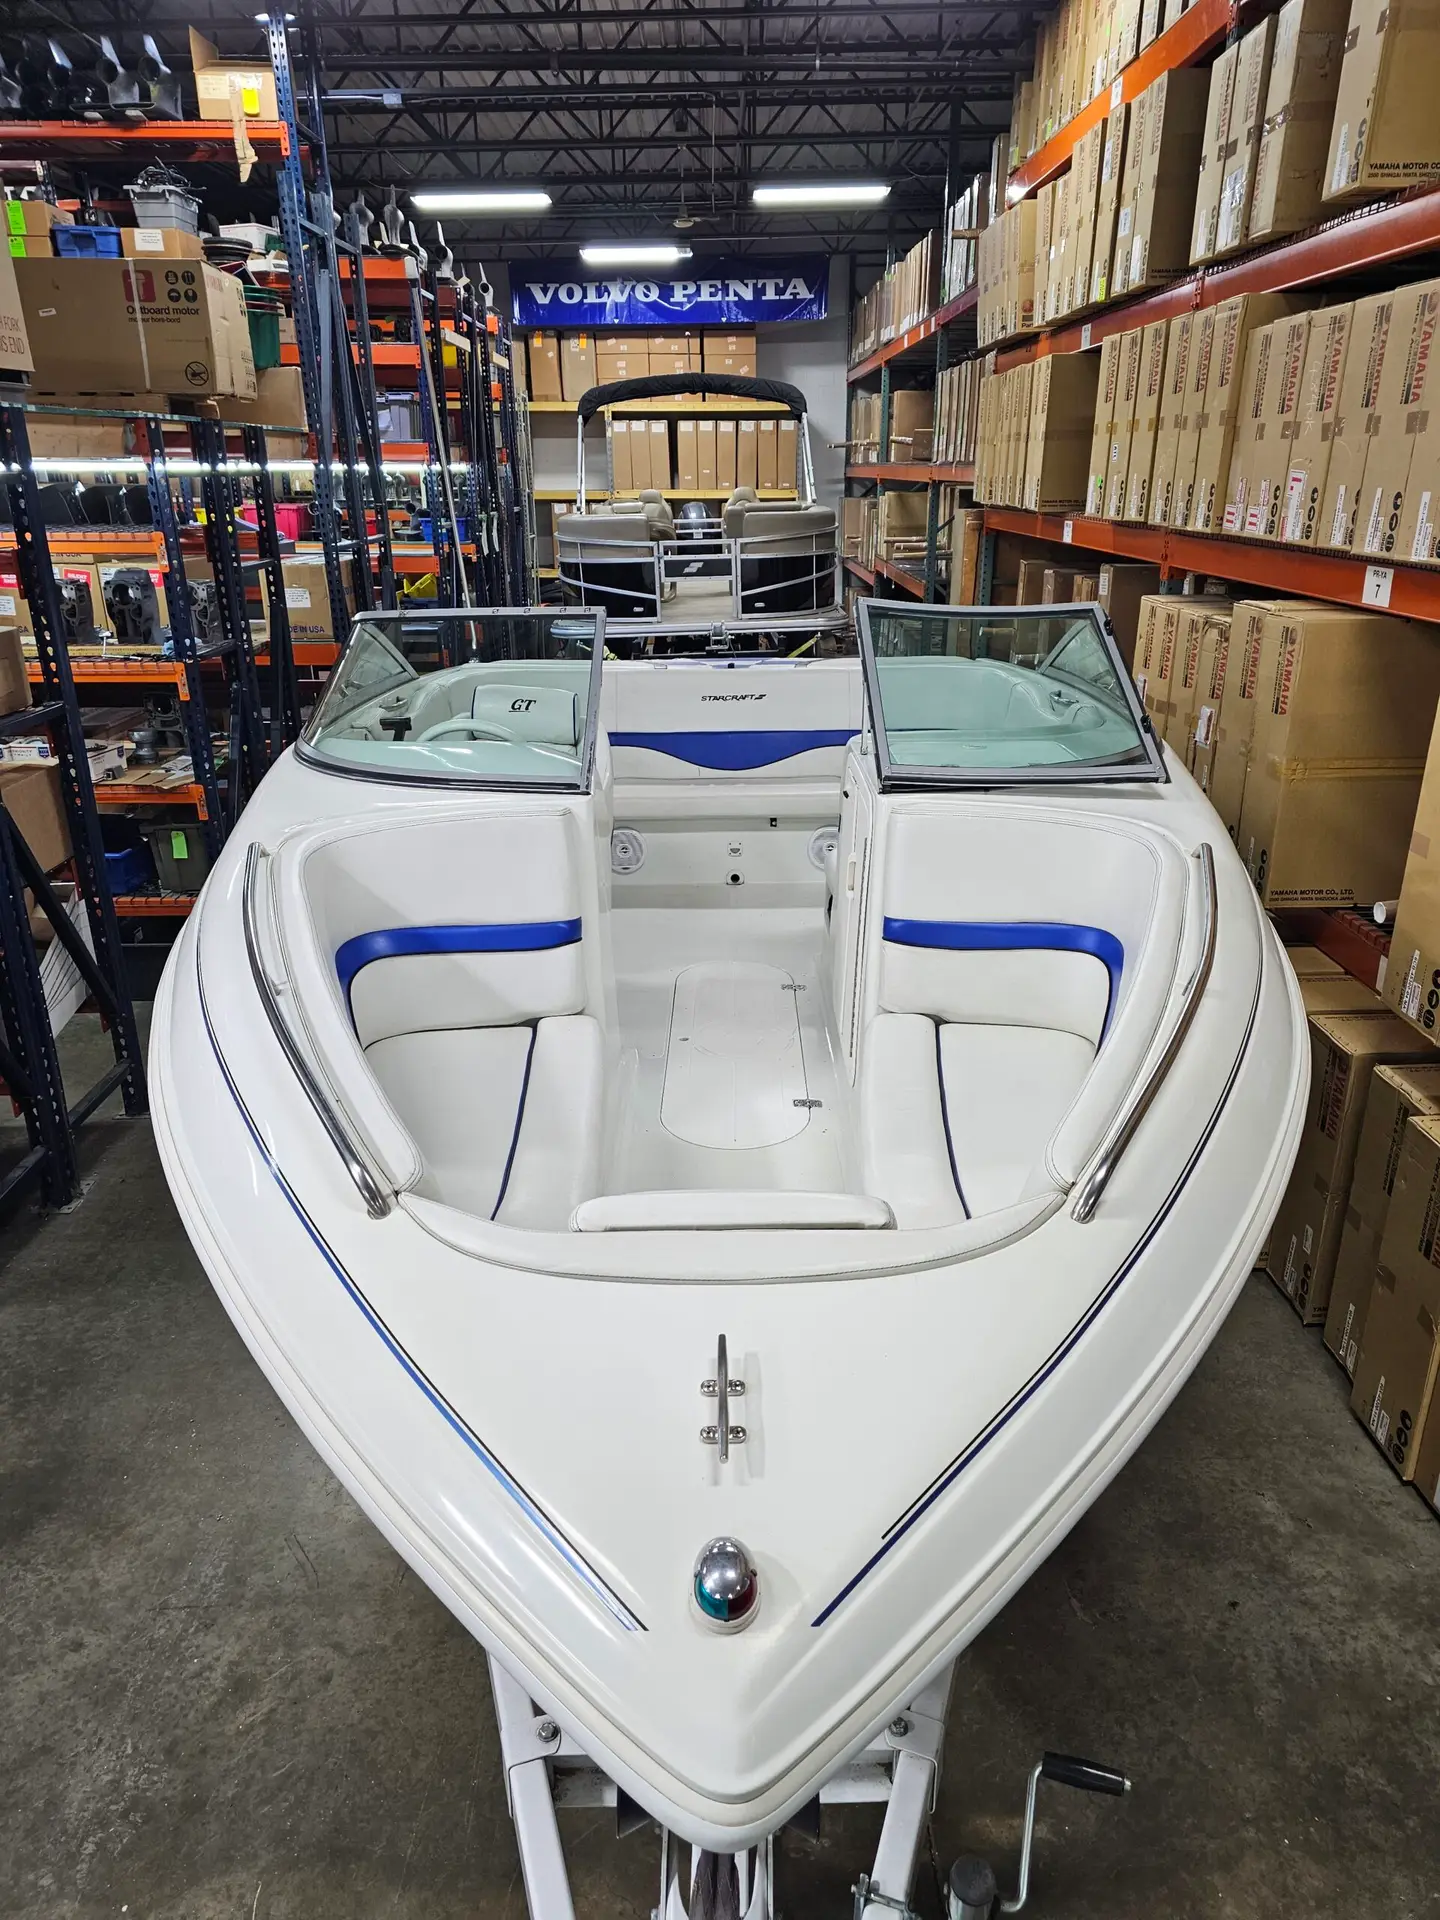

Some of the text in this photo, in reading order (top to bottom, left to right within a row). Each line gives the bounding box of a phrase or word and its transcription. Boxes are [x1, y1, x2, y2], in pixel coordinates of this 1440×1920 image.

[1369, 162, 1400, 170] YAMAHA
[1402, 162, 1429, 170] MOTOR
[126, 304, 200, 316] Otboard motor
[525, 277, 815, 305] VOLVO PENTA
[9, 336, 25, 355] END
[1150, 341, 1163, 396] YAMAHA
[1176, 336, 1190, 394] YAMAHA
[1199, 329, 1212, 392] YAMAHA
[1223, 323, 1237, 387] YAMAHA
[1400, 337, 1415, 405] Accessories
[1410, 315, 1437, 404] YAMAHA
[1284, 343, 1304, 415] YAMAHA
[1323, 337, 1344, 412] YAMAHA
[1372, 569, 1388, 579] PR-YA
[1375, 584, 1381, 598] 7
[300, 625, 307, 633] IN
[309, 625, 325, 634] USA
[1161, 629, 1174, 680] YAMAHA
[1187, 636, 1200, 689] YAMAHA
[1214, 641, 1229, 700] YAMAHA
[1245, 635, 1263, 700] YAMAHA
[1278, 649, 1295, 716] YAMAHA
[509, 698, 537, 712] GT
[701, 694, 756, 702] STARCRAFT
[1383, 1136, 1396, 1192] Accessories
[1417, 1194, 1433, 1254] Accessories
